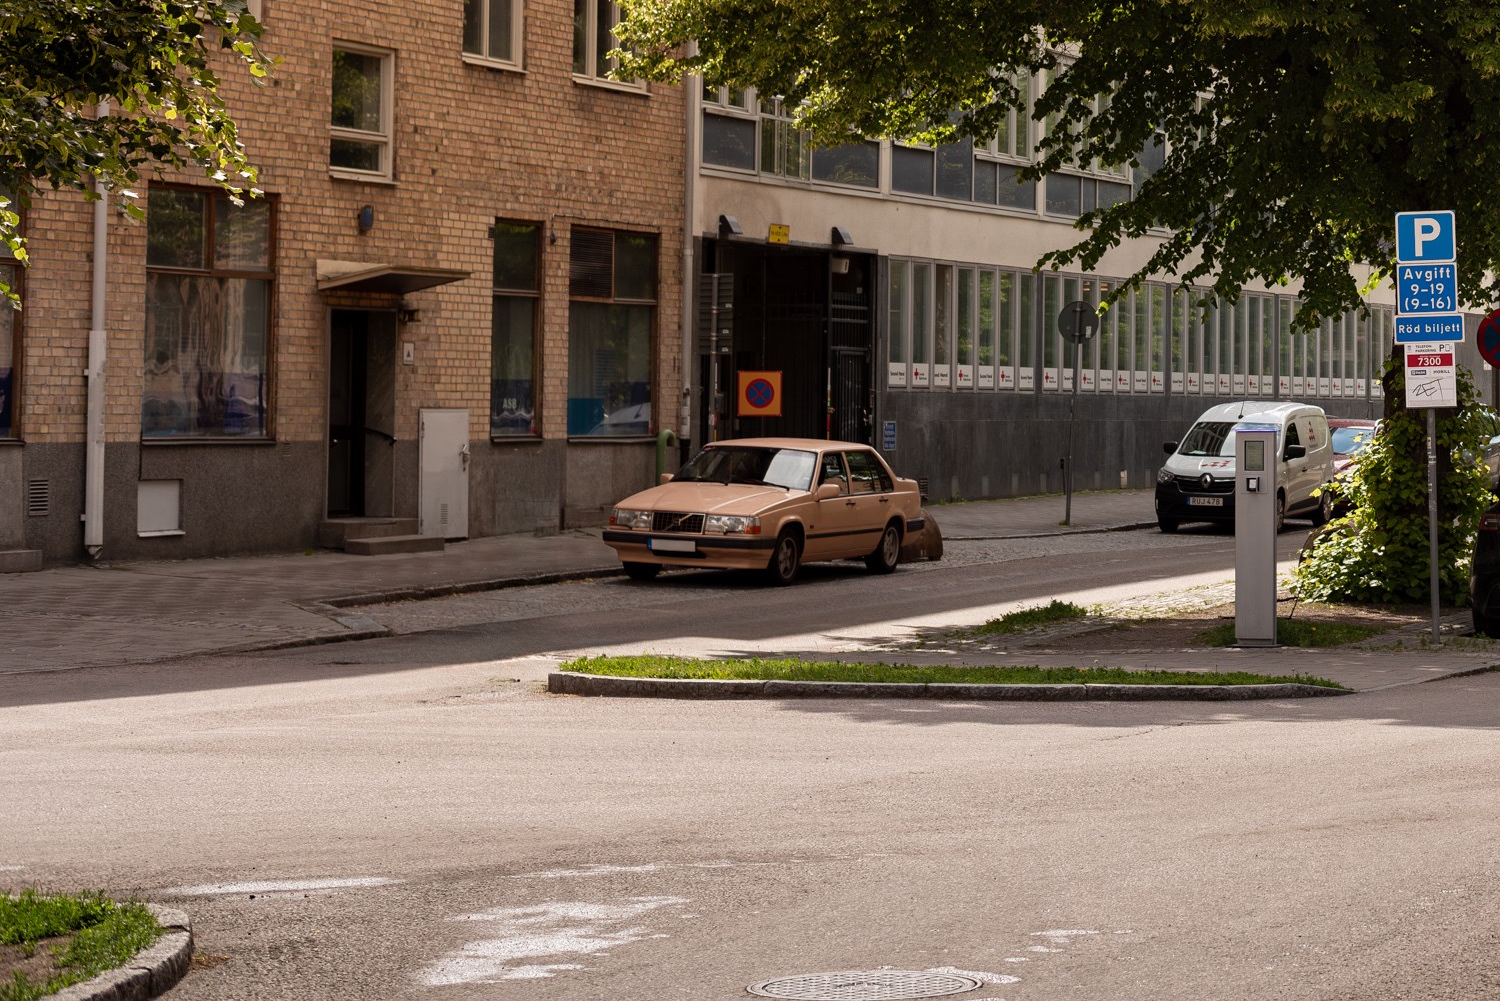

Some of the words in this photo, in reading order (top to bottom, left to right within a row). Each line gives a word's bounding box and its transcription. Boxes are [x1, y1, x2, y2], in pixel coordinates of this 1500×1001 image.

[1414, 218, 1441, 257] P
[1404, 267, 1451, 282] Avgift
[1411, 284, 1445, 295] 9-19
[1404, 297, 1452, 311] (9-16)
[1398, 324, 1421, 334] Röd
[1425, 323, 1460, 335] biljett
[1417, 358, 1441, 366] 7300
